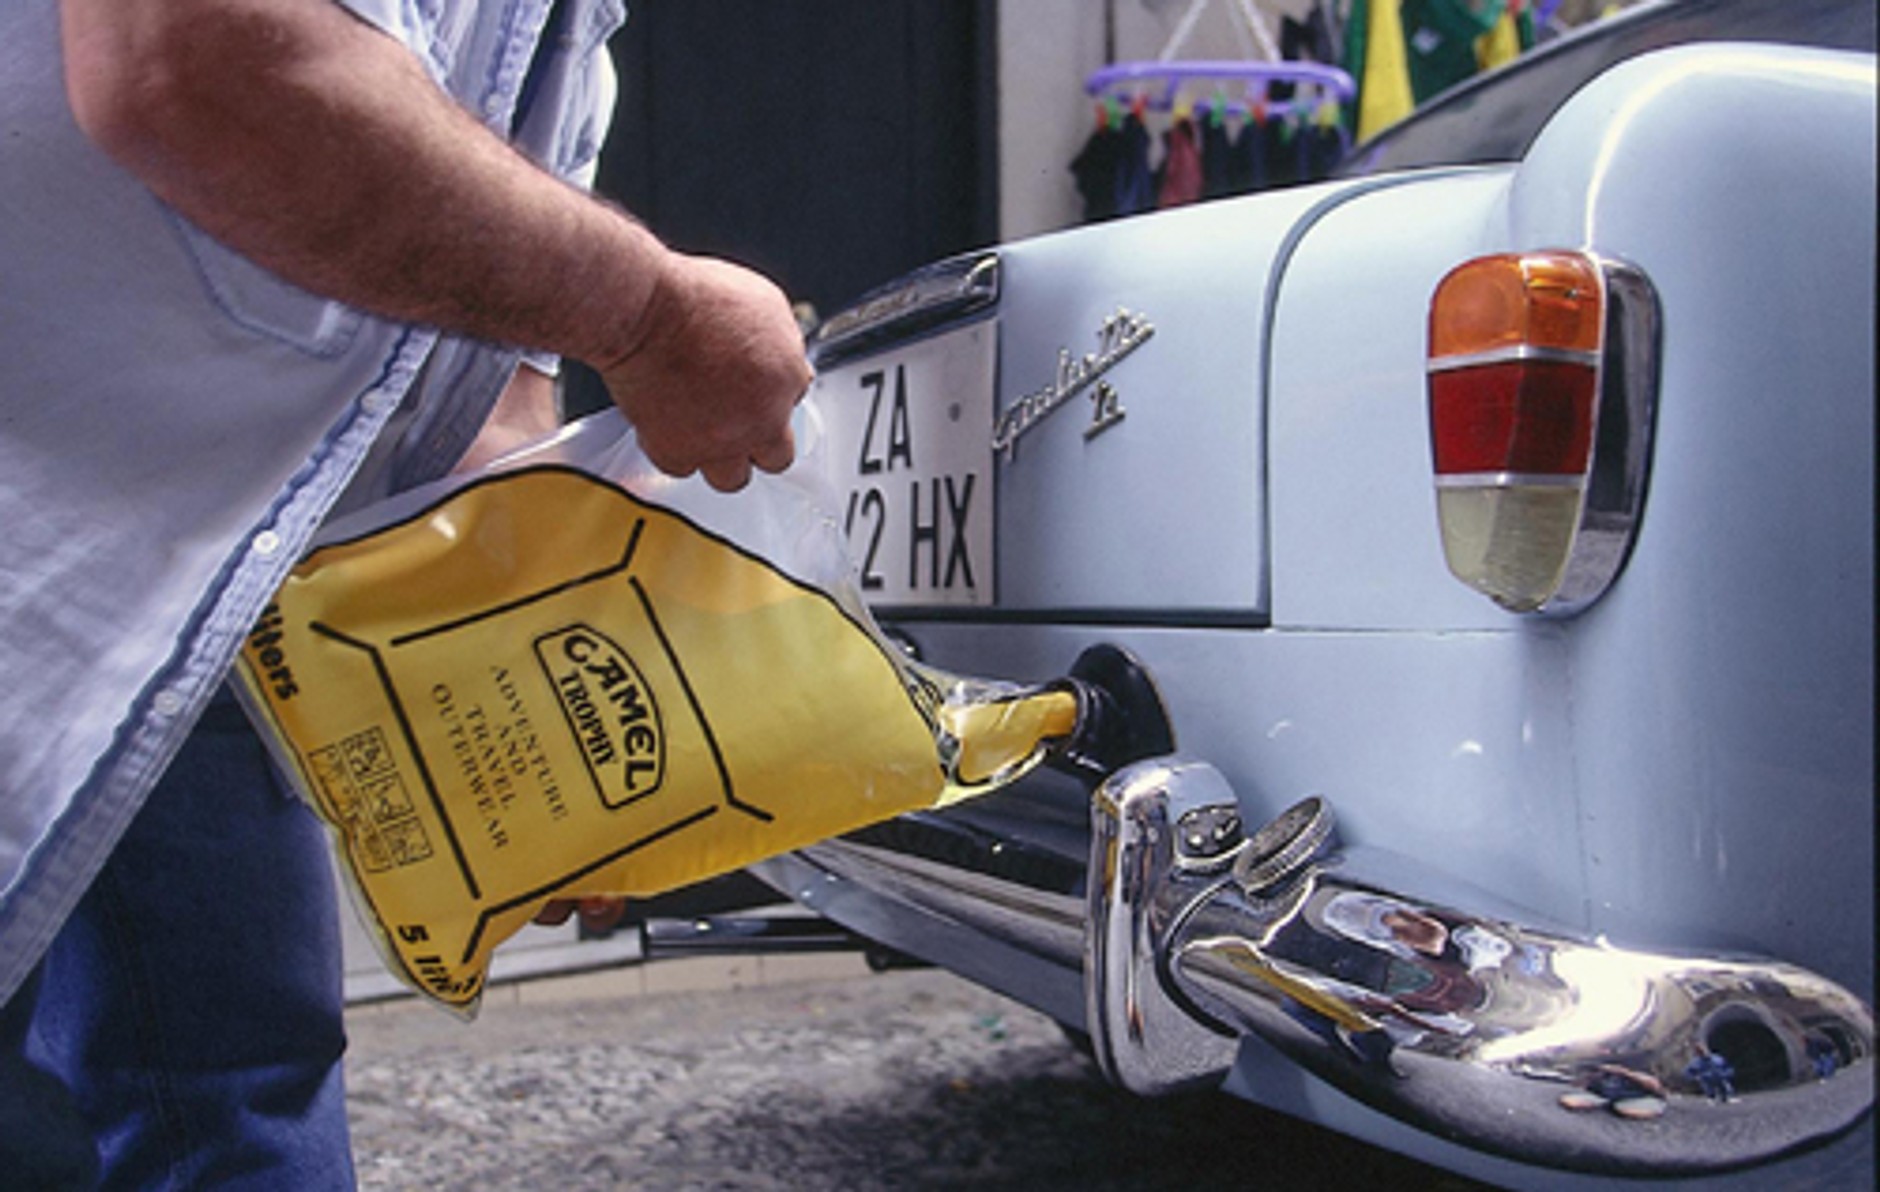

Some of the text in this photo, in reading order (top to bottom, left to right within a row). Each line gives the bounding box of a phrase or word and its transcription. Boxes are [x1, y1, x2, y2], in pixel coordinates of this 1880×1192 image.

[859, 364, 912, 475] ZA
[909, 473, 976, 589] HX
[431, 683, 509, 850] OUTERWEAR
[466, 704, 517, 810] TRAVEL
[491, 665, 568, 821] ADVENTURE
[495, 727, 525, 777] AND
[558, 671, 618, 766] TROPHY
[562, 633, 657, 791] CAMEL
[397, 924, 430, 945] 5
